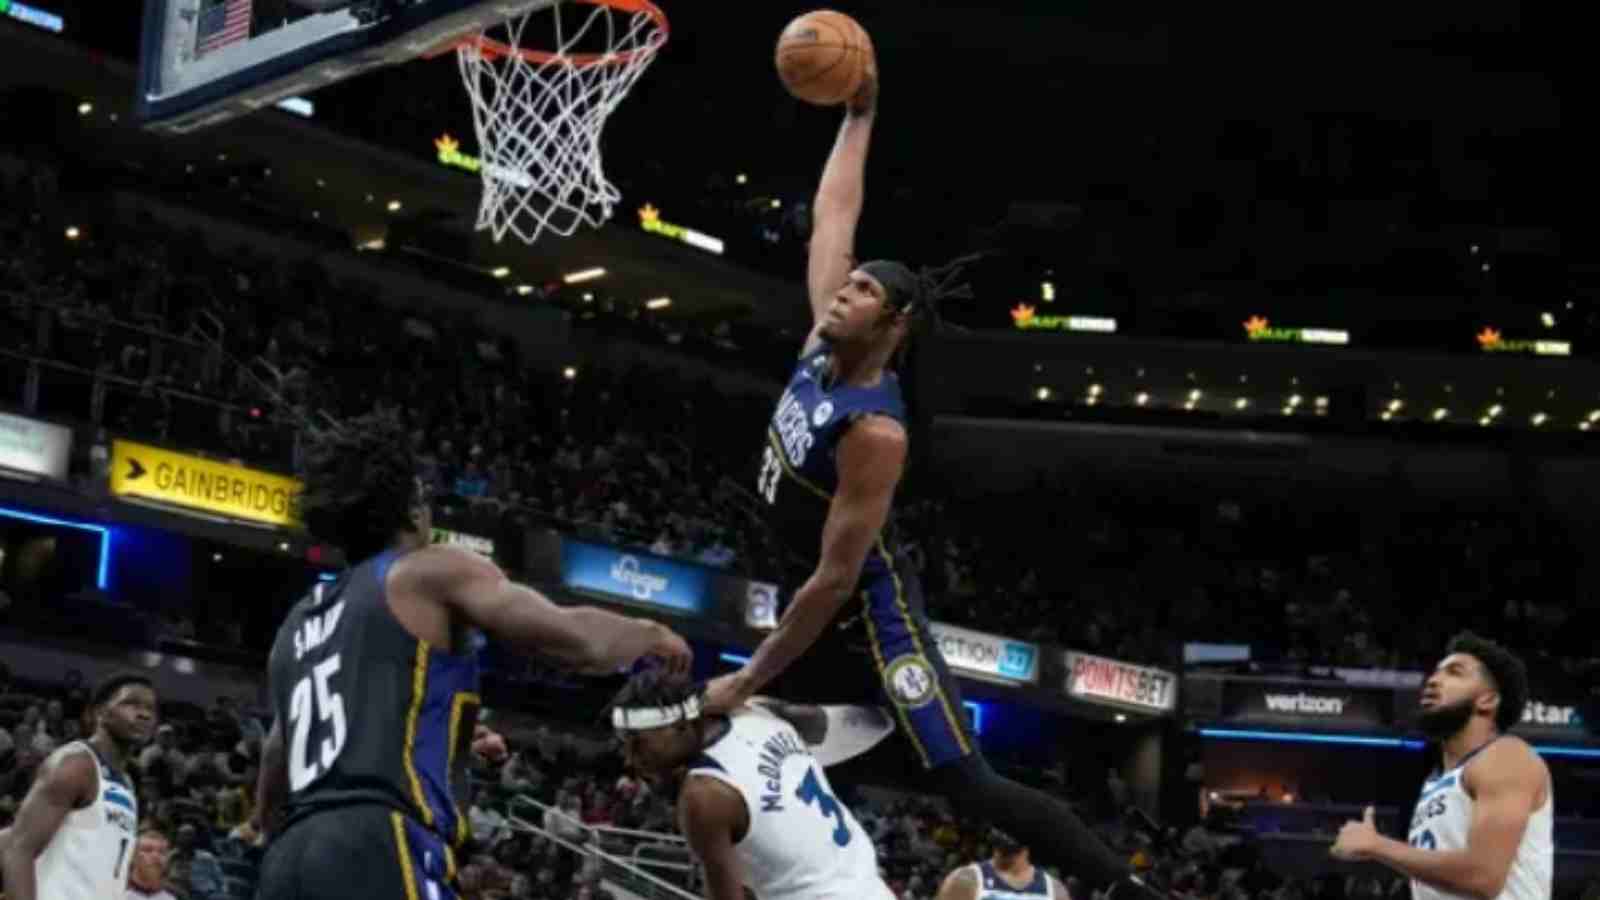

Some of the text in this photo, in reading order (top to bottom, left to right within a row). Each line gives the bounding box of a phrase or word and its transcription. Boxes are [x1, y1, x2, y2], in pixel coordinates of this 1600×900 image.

[290, 652, 347, 792] 25
[1264, 693, 1344, 714] verizon
[795, 764, 852, 848] 3
[113, 838, 127, 879] 1
